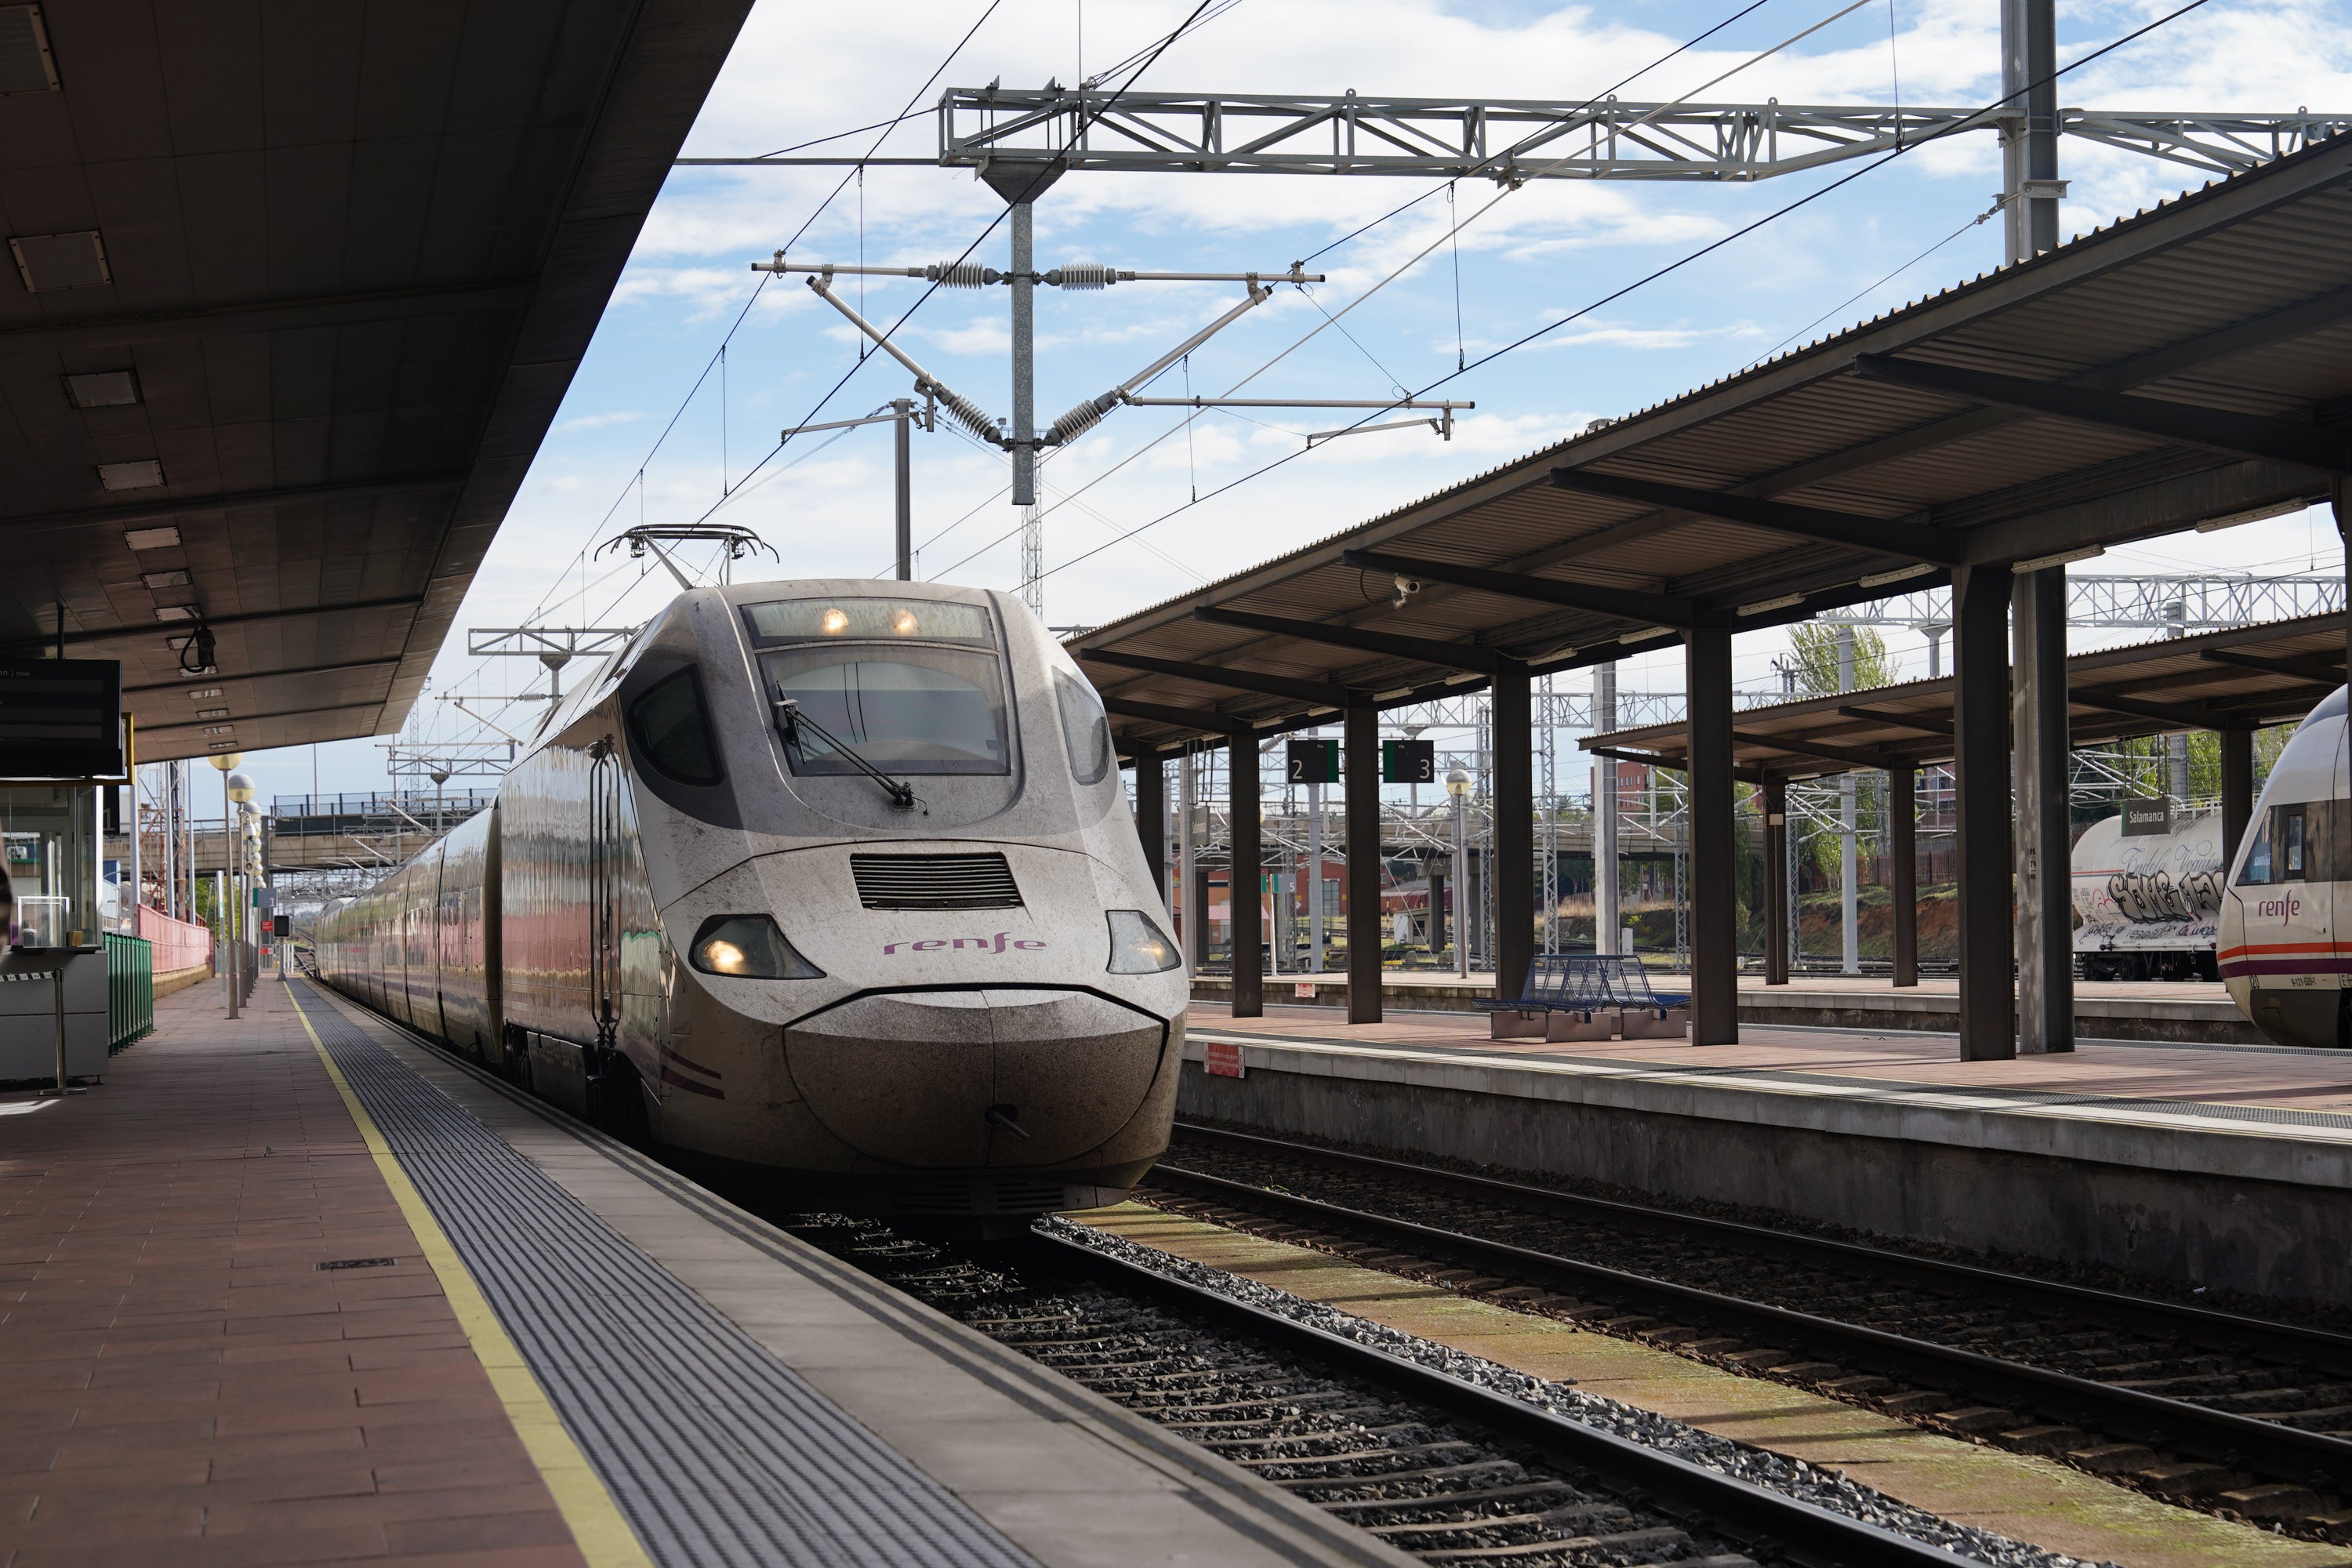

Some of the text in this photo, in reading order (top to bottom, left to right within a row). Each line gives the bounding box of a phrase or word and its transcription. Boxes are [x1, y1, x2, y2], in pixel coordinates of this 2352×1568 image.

[1292, 759, 1303, 779] 2
[1419, 759, 1430, 779] 3
[103, 808, 115, 831] 1
[2129, 810, 2164, 824] Salamanca
[1289, 882, 1295, 891] 5
[269, 897, 276, 907] 1
[2258, 889, 2300, 927] renfe
[884, 931, 1047, 955] renfe
